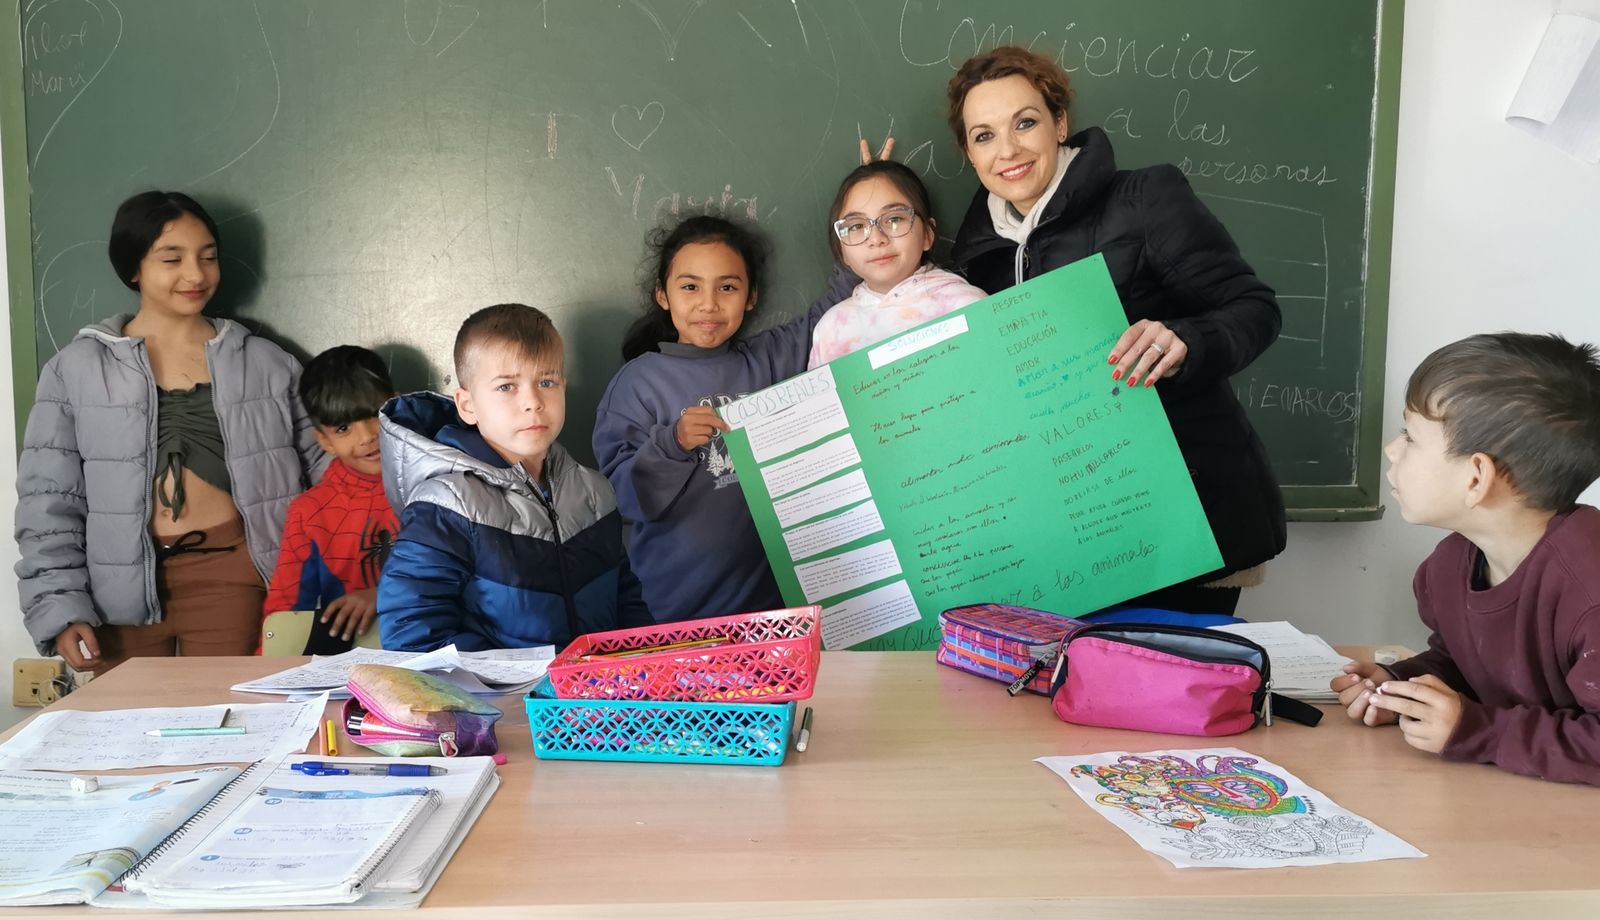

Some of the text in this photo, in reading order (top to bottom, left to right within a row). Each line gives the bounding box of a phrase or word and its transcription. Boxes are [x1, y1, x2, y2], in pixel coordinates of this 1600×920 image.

[1177, 156, 1317, 186] personas
[992, 291, 1032, 314] RESPETO
[1015, 356, 1040, 376] AMOR
[1038, 401, 1113, 445] VALORES
